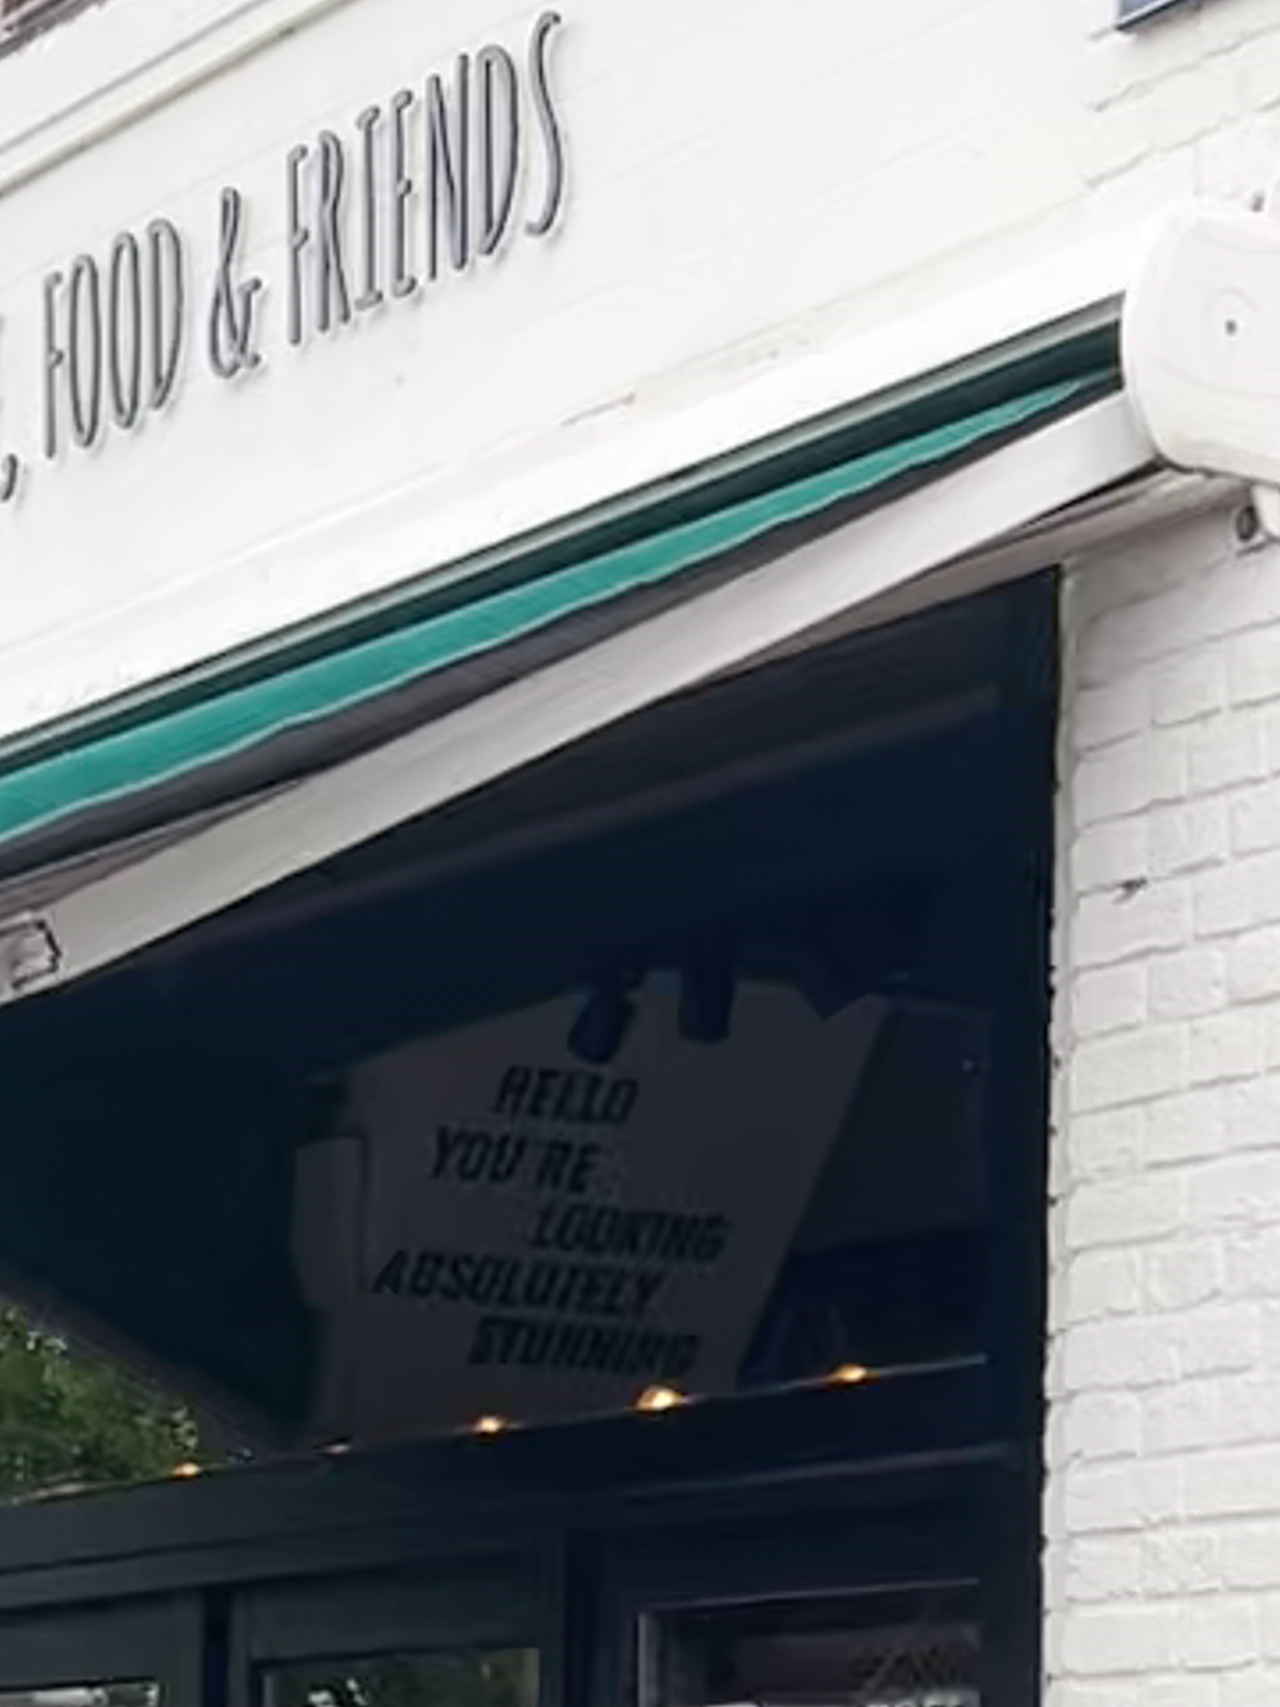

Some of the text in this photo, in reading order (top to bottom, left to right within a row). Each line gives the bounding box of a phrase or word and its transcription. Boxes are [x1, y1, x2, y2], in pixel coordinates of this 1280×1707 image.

[42, 219, 185, 460] FOOD
[208, 186, 261, 379] &
[286, 11, 567, 346] FRIENDS
[493, 1066, 637, 1122] HELLO
[431, 1128, 599, 1190] YOU'RE
[534, 1203, 730, 1260] LOOKING
[374, 1251, 664, 1311] ABSOLUTELY
